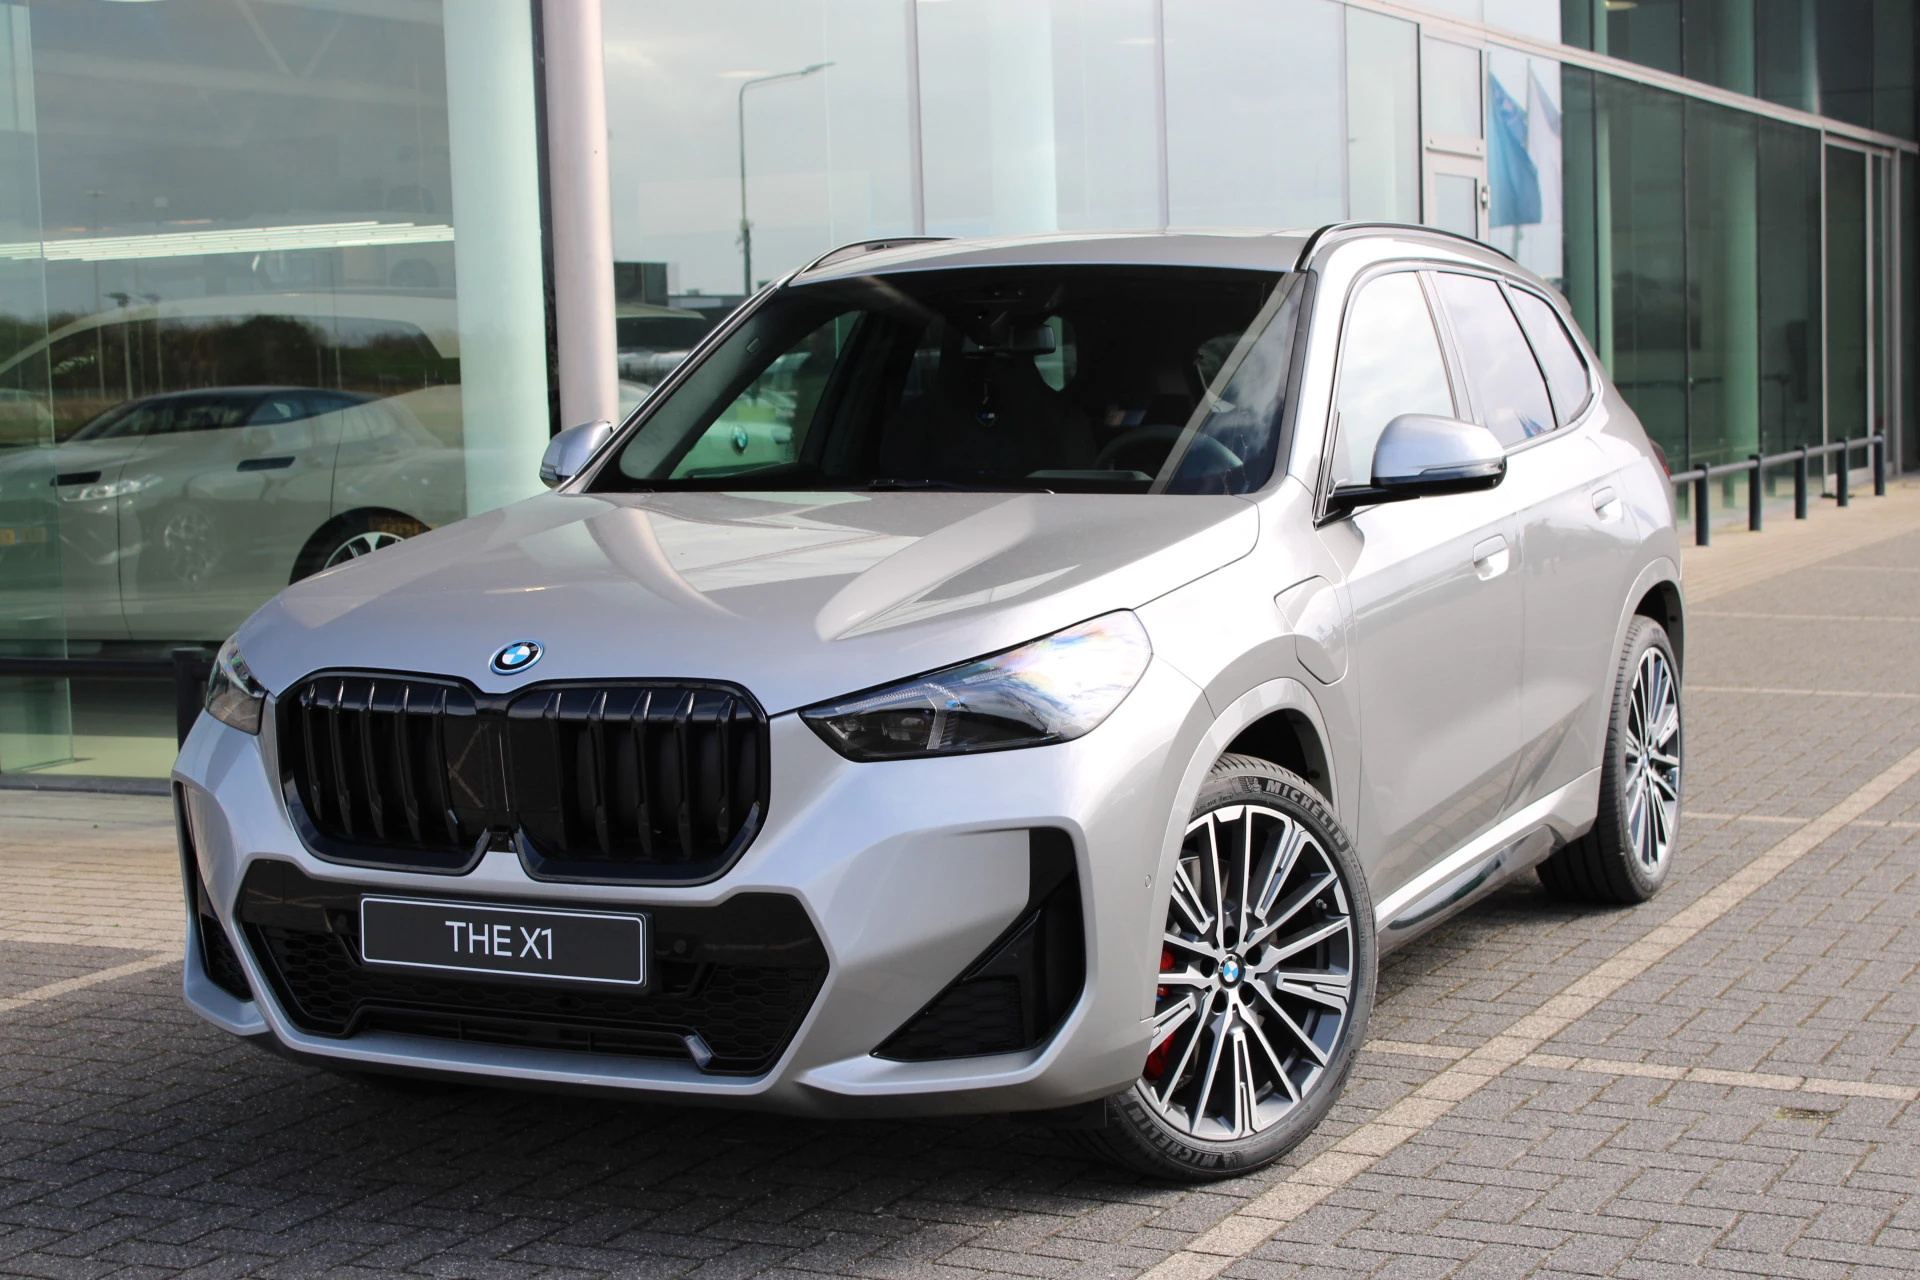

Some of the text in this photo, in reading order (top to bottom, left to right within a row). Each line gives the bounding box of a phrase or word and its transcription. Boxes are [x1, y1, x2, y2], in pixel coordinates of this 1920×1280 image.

[1265, 779, 1346, 847] MICHELIN
[445, 920, 553, 960] THE X1
[1127, 1107, 1220, 1168] MICHELIN
